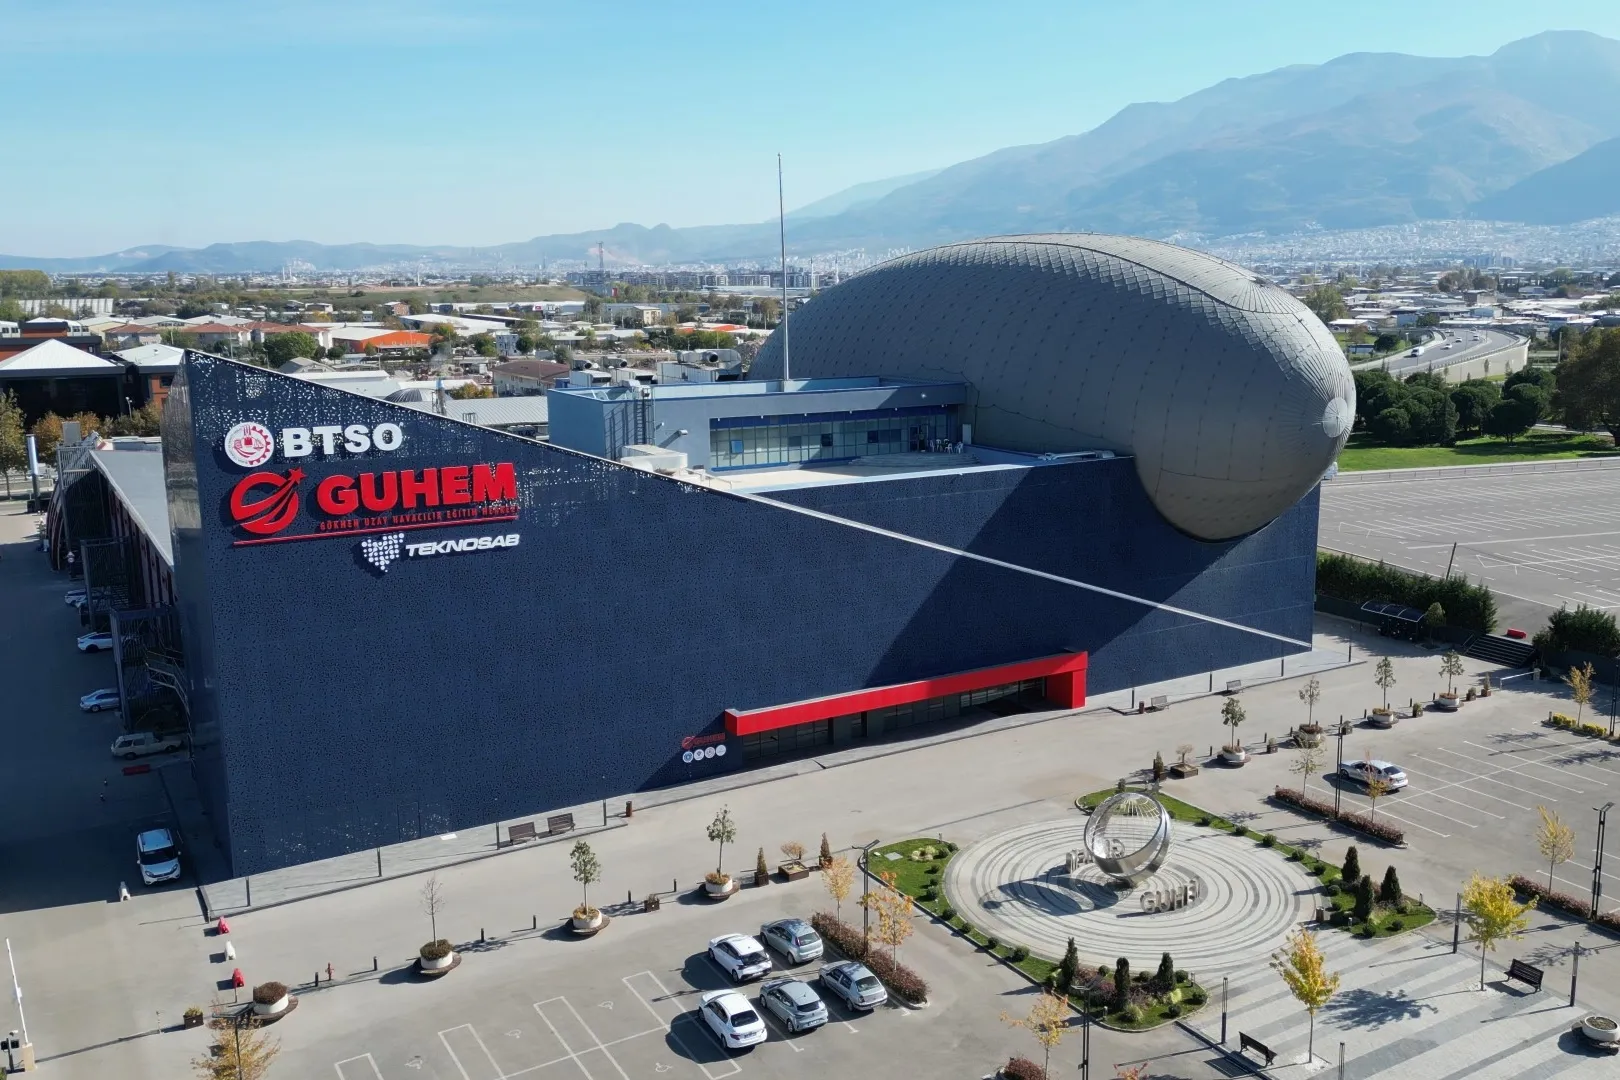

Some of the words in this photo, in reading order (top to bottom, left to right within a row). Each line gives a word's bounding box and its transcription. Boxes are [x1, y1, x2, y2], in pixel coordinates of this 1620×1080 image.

[282, 422, 402, 457] BTSO
[317, 463, 517, 516] GUHEM
[364, 516, 388, 526] UZAY
[405, 533, 520, 557] TEKNOSAB
